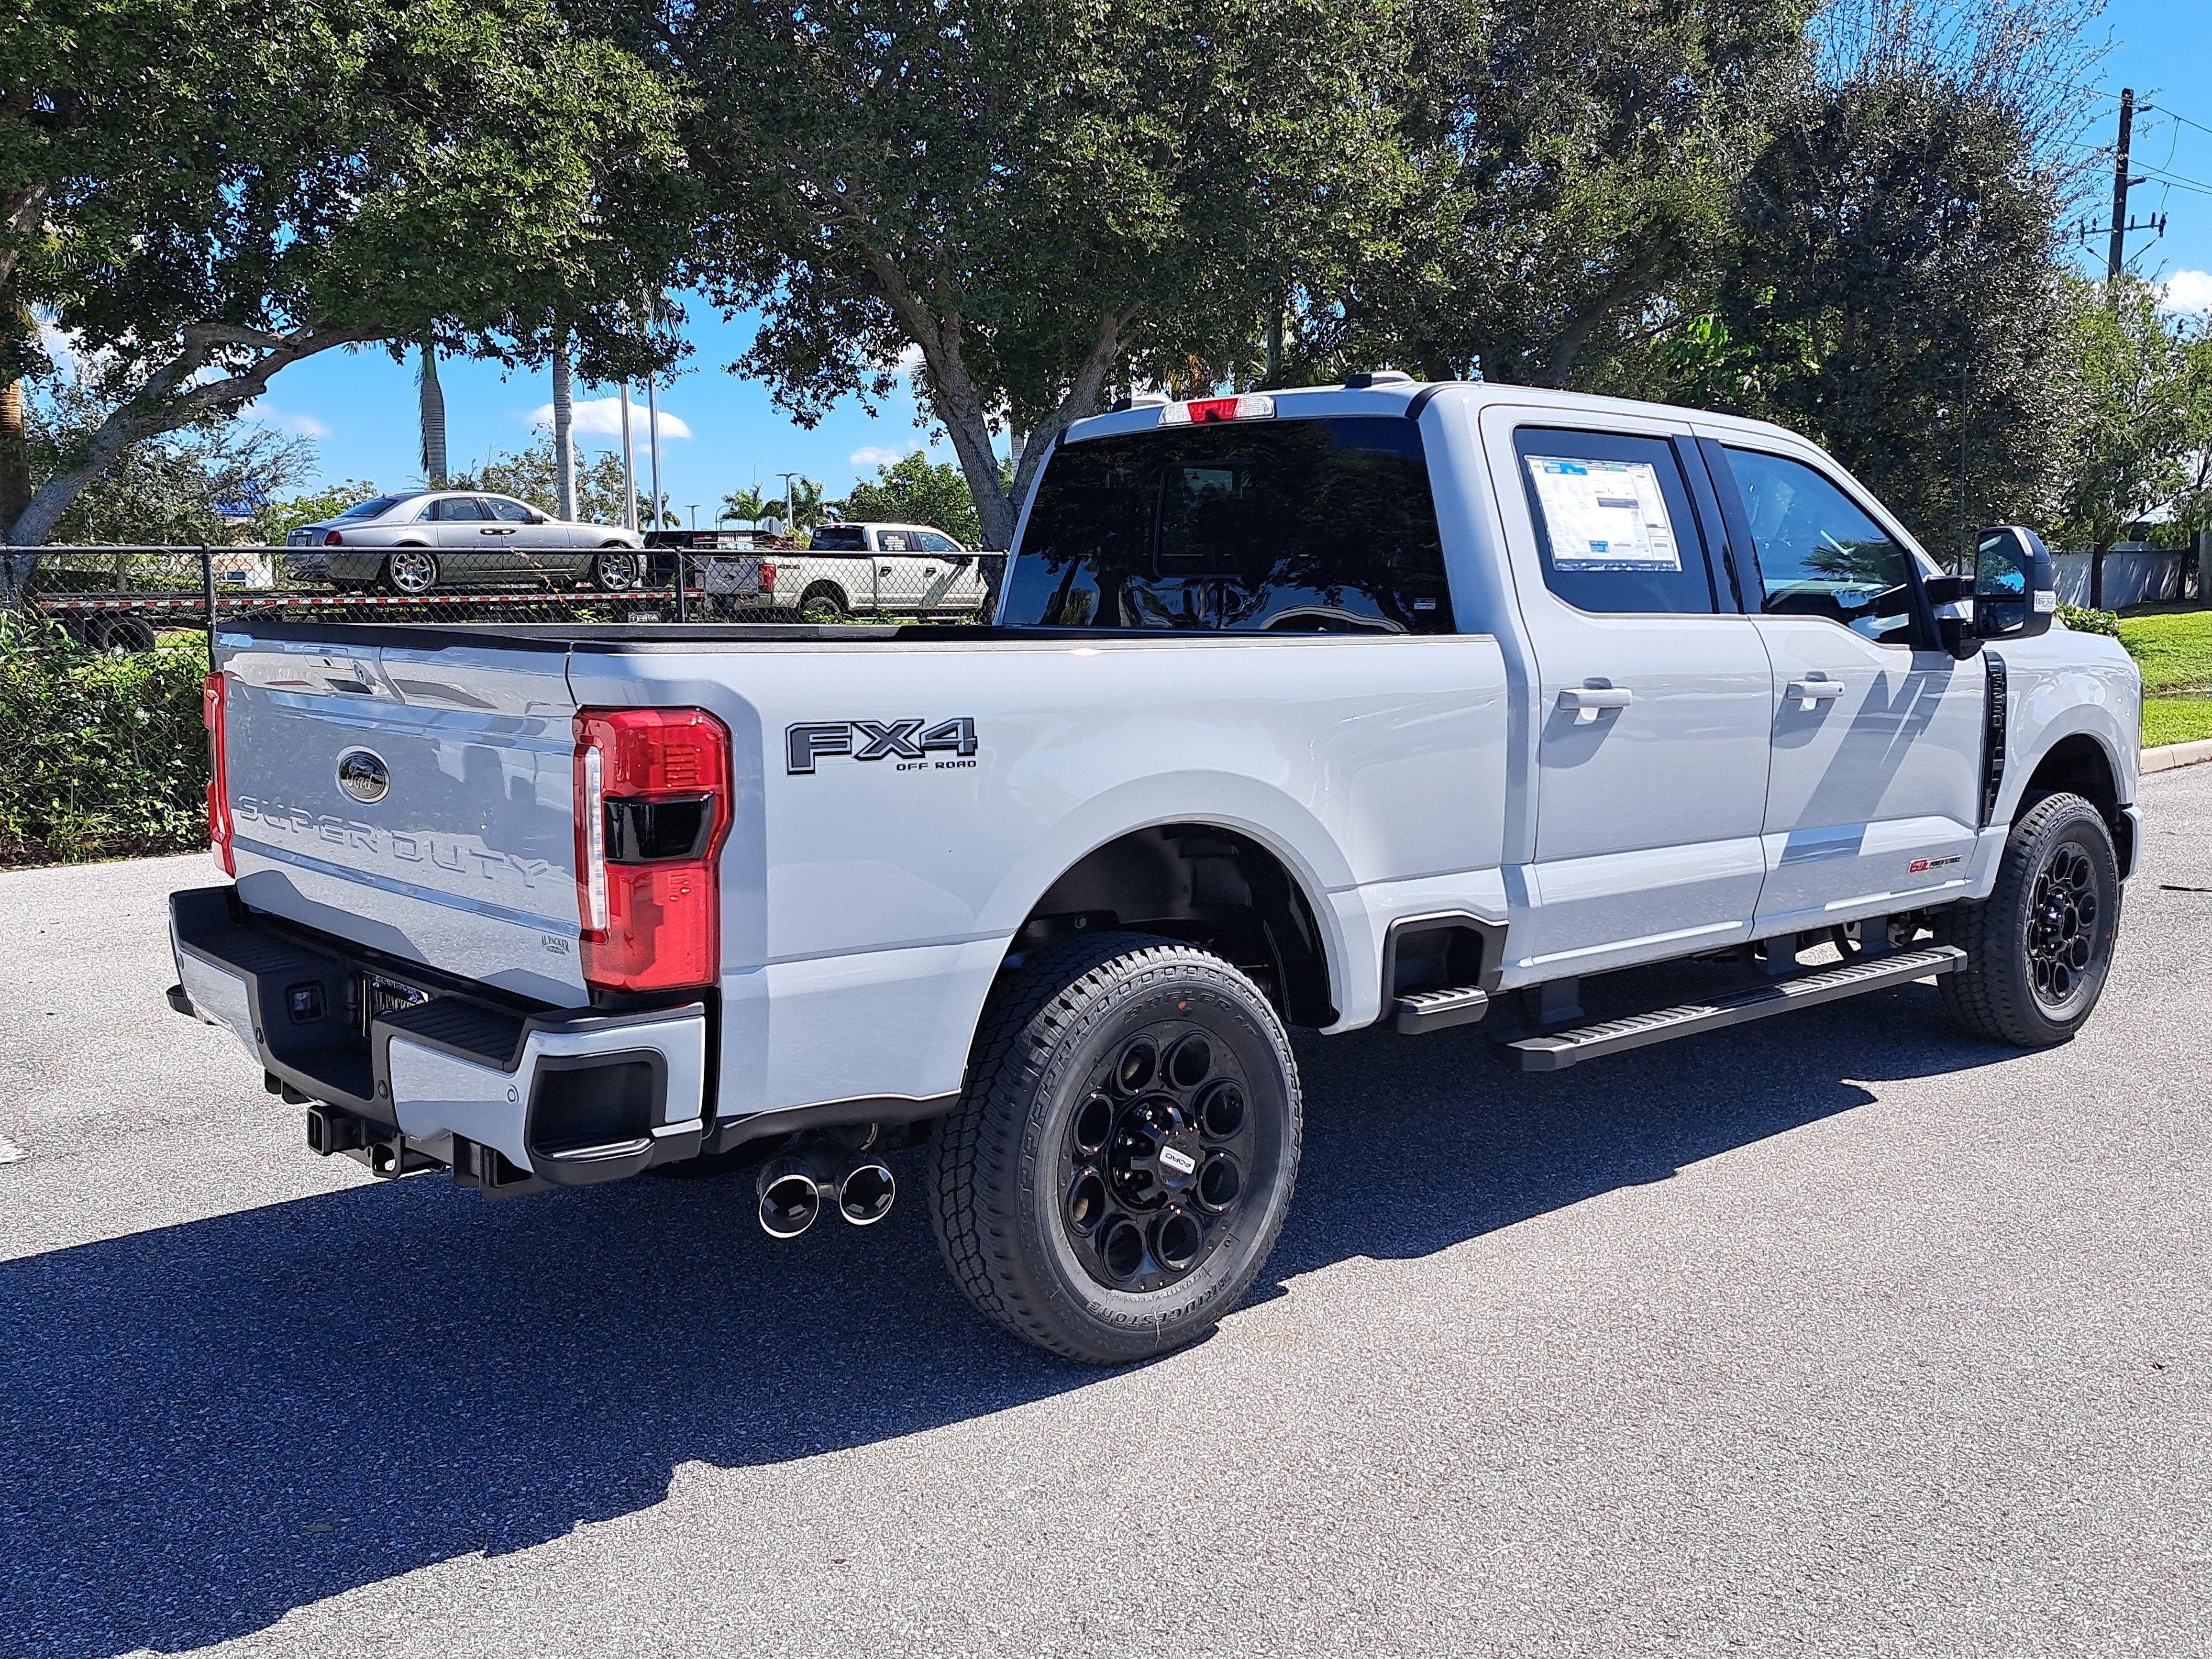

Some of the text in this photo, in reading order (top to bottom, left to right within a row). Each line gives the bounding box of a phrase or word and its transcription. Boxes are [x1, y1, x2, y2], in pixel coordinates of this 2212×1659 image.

[785, 716, 978, 776] FX4
[346, 762, 374, 792] Ford
[896, 760, 977, 771] OFF ROAD
[238, 794, 548, 889] SUPER DUTY
[548, 936, 570, 953] PACKER
[1165, 1152, 1192, 1168] FORD
[1086, 1266, 1233, 1328] BRIDGESTONE
